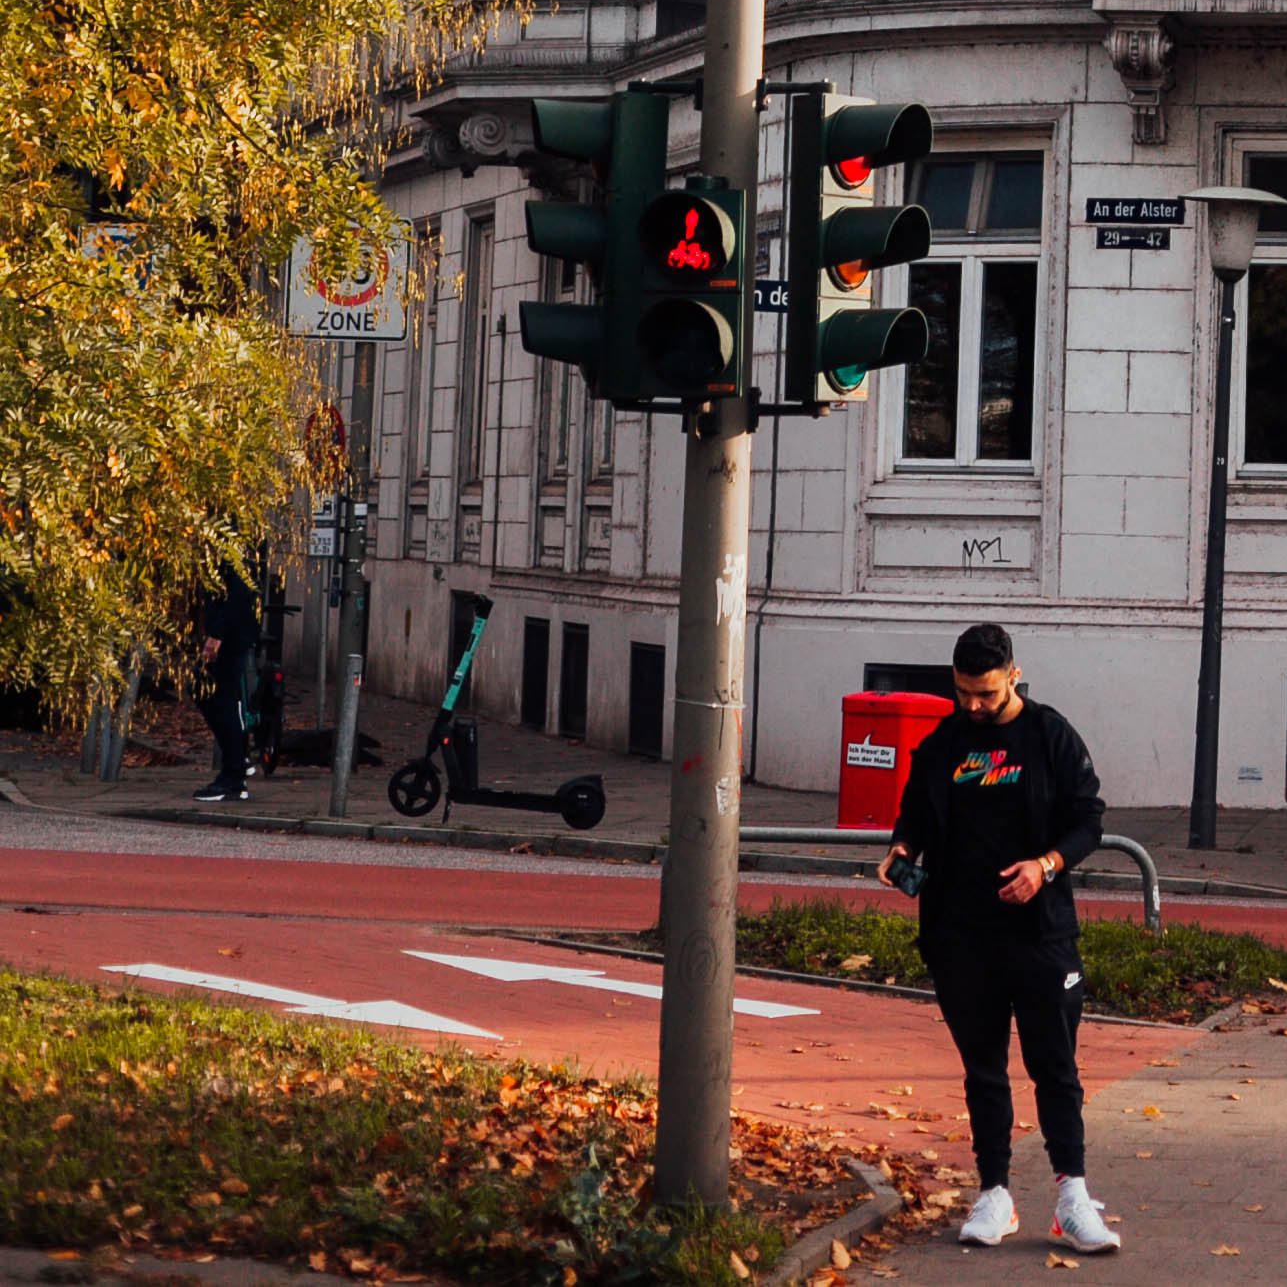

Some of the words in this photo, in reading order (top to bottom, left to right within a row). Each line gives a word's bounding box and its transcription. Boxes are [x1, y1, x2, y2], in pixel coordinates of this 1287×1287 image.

[1093, 201, 1109, 217] An
[1114, 202, 1136, 217] der
[1140, 202, 1178, 218] Alster
[1104, 230, 1120, 246] 29
[1146, 232, 1163, 246] 47
[316, 311, 377, 332] ZONE
